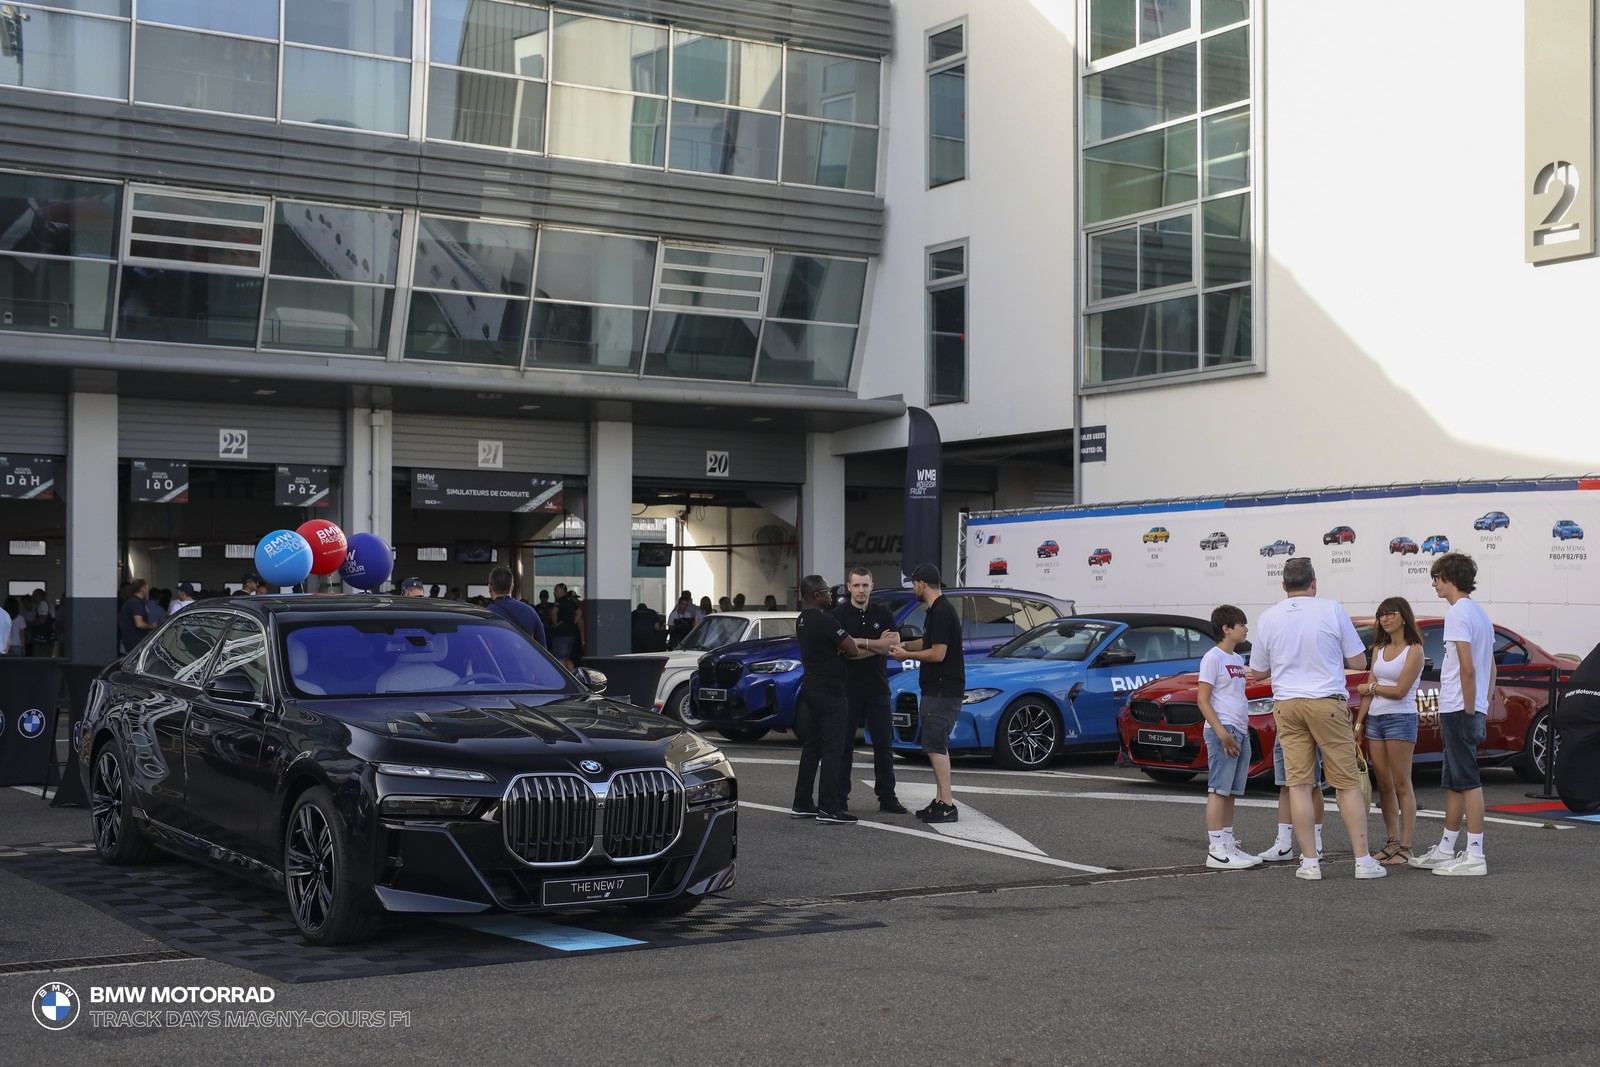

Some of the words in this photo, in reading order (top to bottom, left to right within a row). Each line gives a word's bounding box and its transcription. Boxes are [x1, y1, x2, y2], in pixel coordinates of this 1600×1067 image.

[1533, 160, 1580, 246] 2
[220, 432, 246, 455] 22
[480, 443, 501, 464] 21
[707, 453, 728, 473] 20
[6, 474, 15, 486] D
[18, 474, 27, 486] à
[30, 475, 40, 486] H
[146, 479, 150, 489] I
[153, 479, 161, 490] à
[164, 479, 174, 490] O
[416, 473, 435, 481] BMW
[288, 483, 296, 494] P
[298, 484, 306, 494] à
[309, 484, 317, 495] Z
[446, 488, 490, 497] SIMULATEURS
[499, 490, 530, 498] CONDUITE
[316, 525, 342, 540] BMW
[263, 531, 293, 554] BMW
[268, 537, 299, 559] PASSION
[570, 882, 591, 893] THE
[593, 880, 616, 891] NEW
[616, 879, 625, 889] i7
